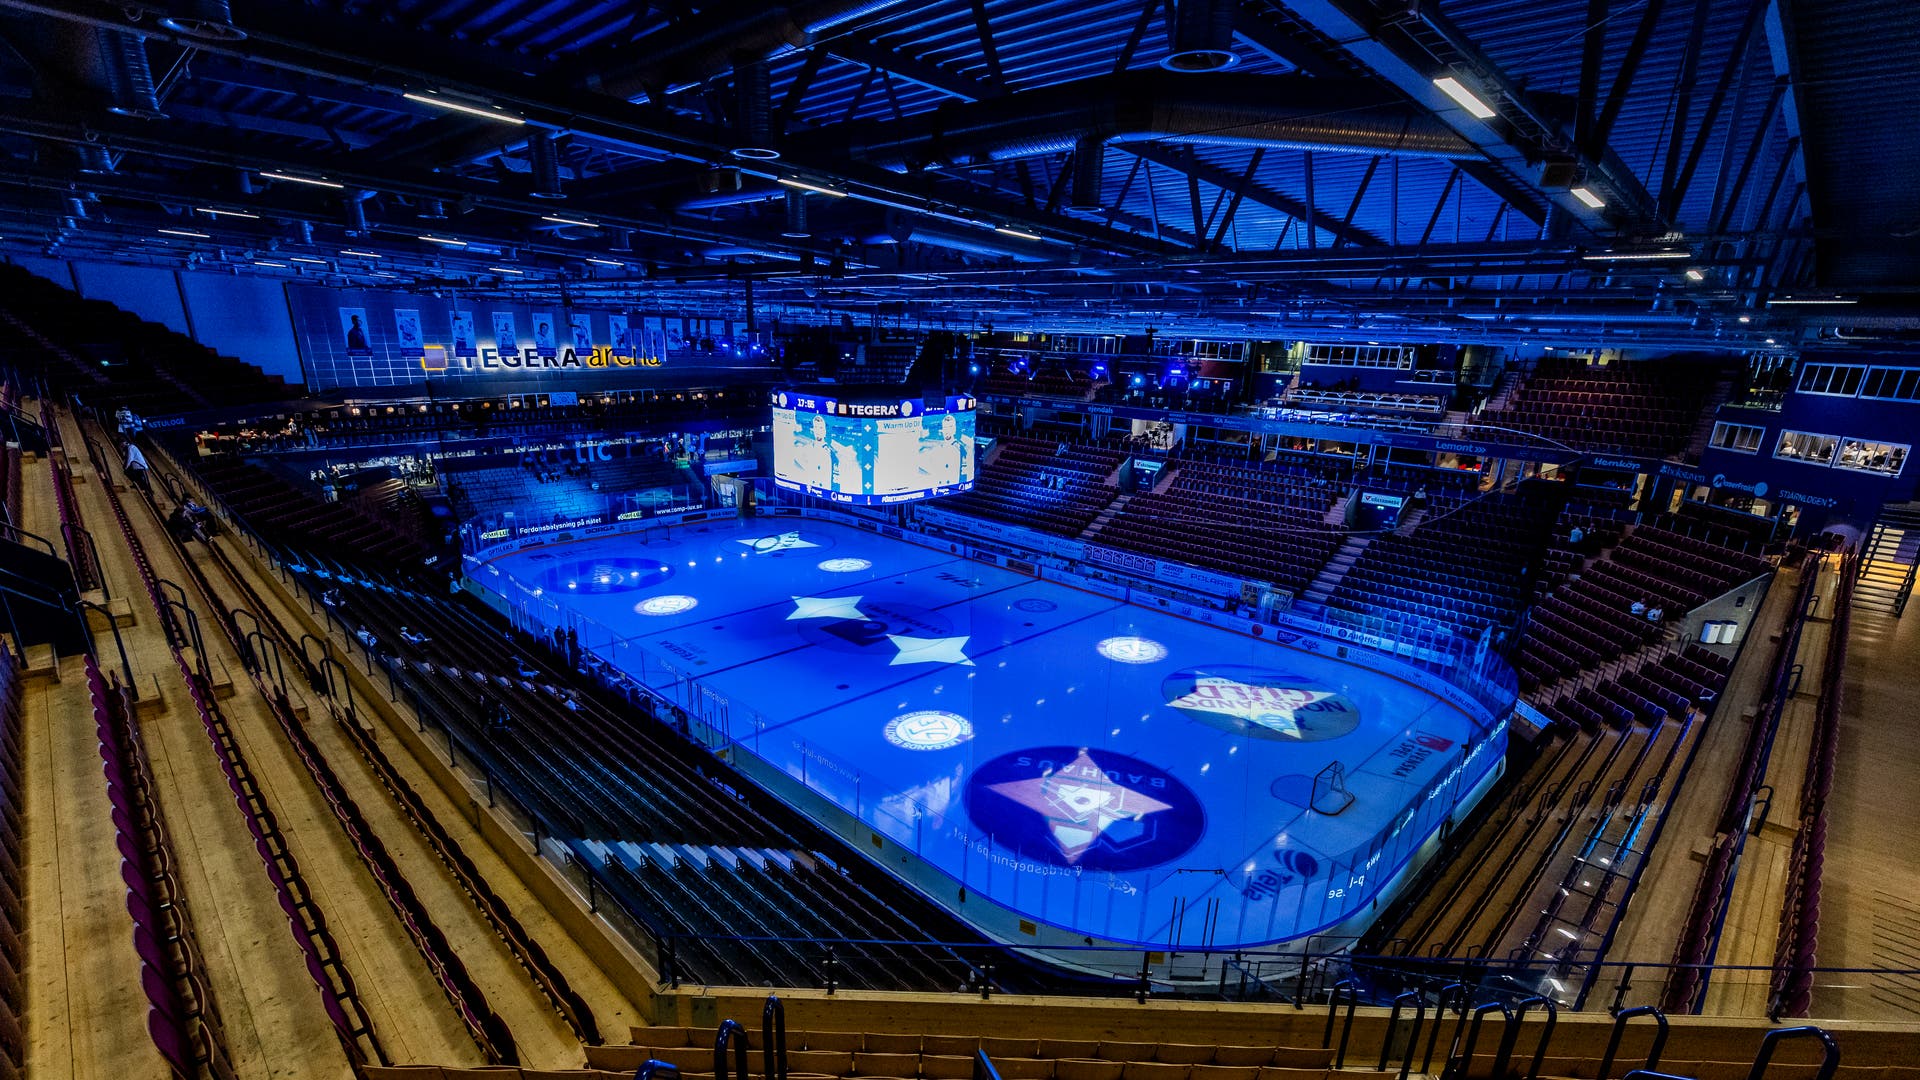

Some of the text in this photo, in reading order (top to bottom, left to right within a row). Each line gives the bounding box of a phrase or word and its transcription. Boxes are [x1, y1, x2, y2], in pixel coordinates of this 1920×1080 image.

[848, 403, 898, 416] TEGERA
[1435, 441, 1474, 453] Lemont
[1190, 573, 1234, 589] POLARIS
[1016, 756, 1166, 788] BAUHAUS
